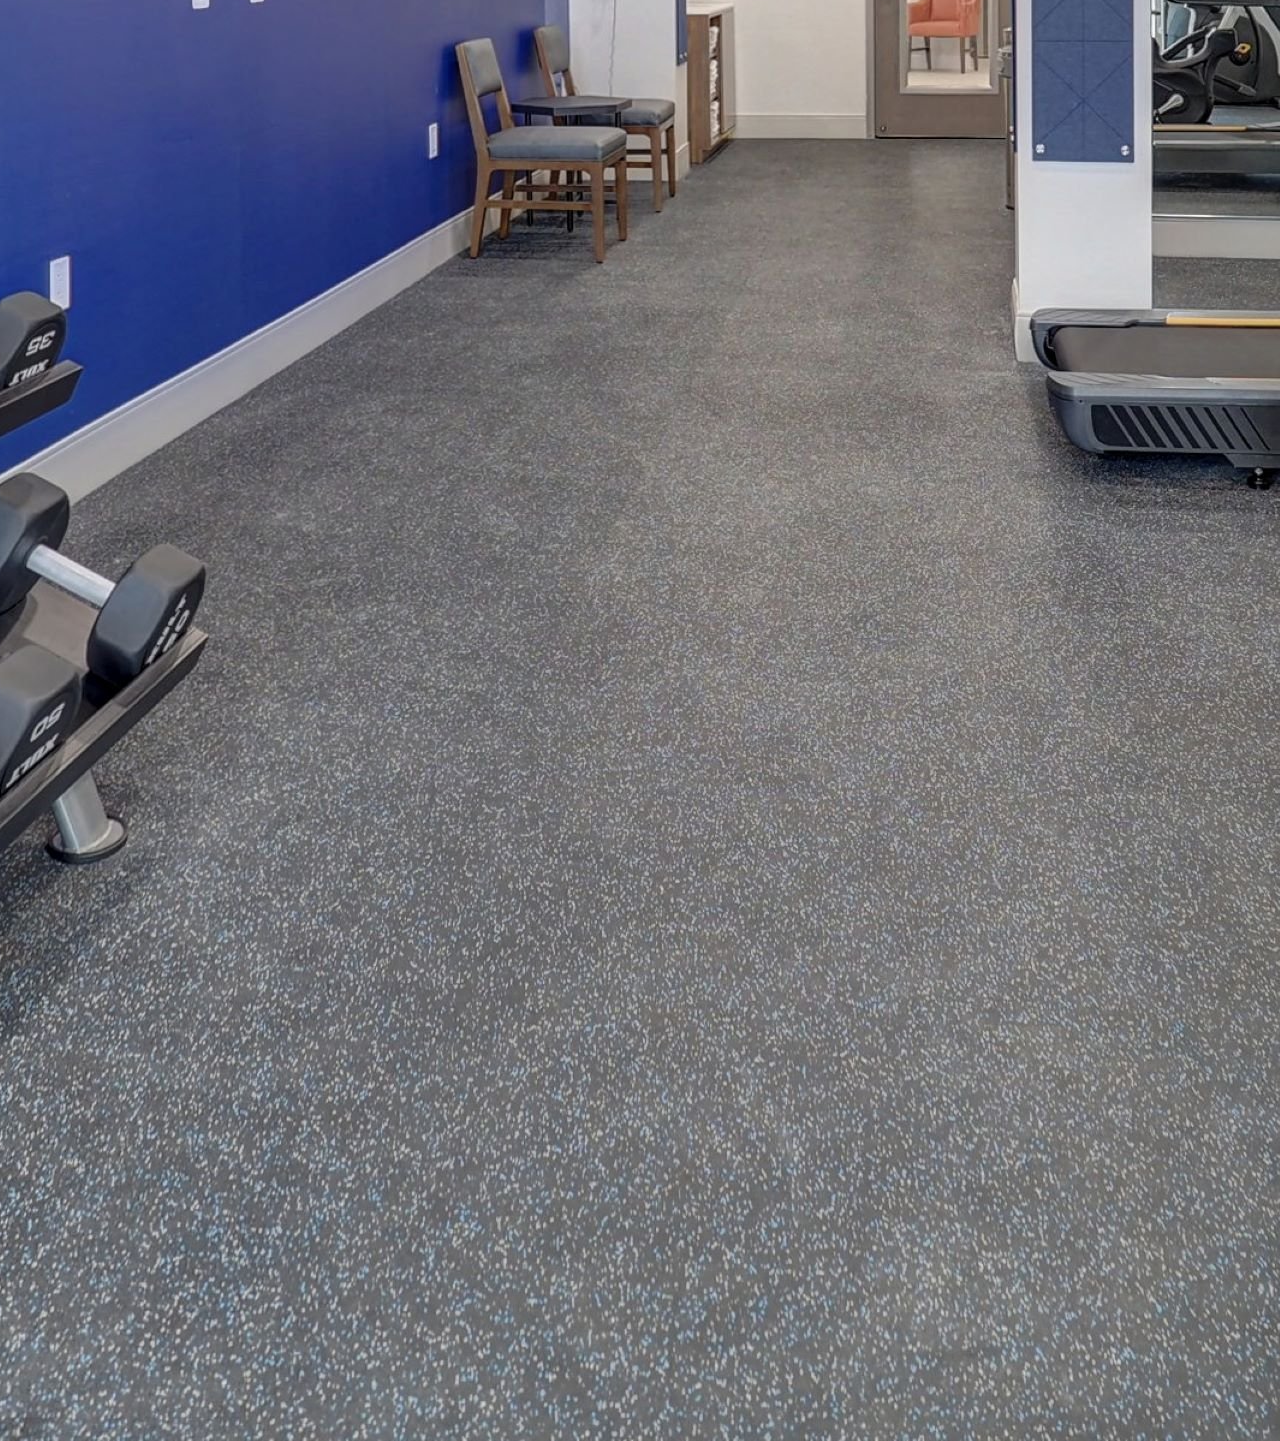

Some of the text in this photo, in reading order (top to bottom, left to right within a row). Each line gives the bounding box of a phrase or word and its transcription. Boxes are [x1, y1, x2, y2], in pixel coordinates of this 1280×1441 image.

[25, 329, 56, 357] 35
[8, 358, 49, 386] XULT
[30, 702, 66, 743] 50
[5, 732, 59, 788] XULT
